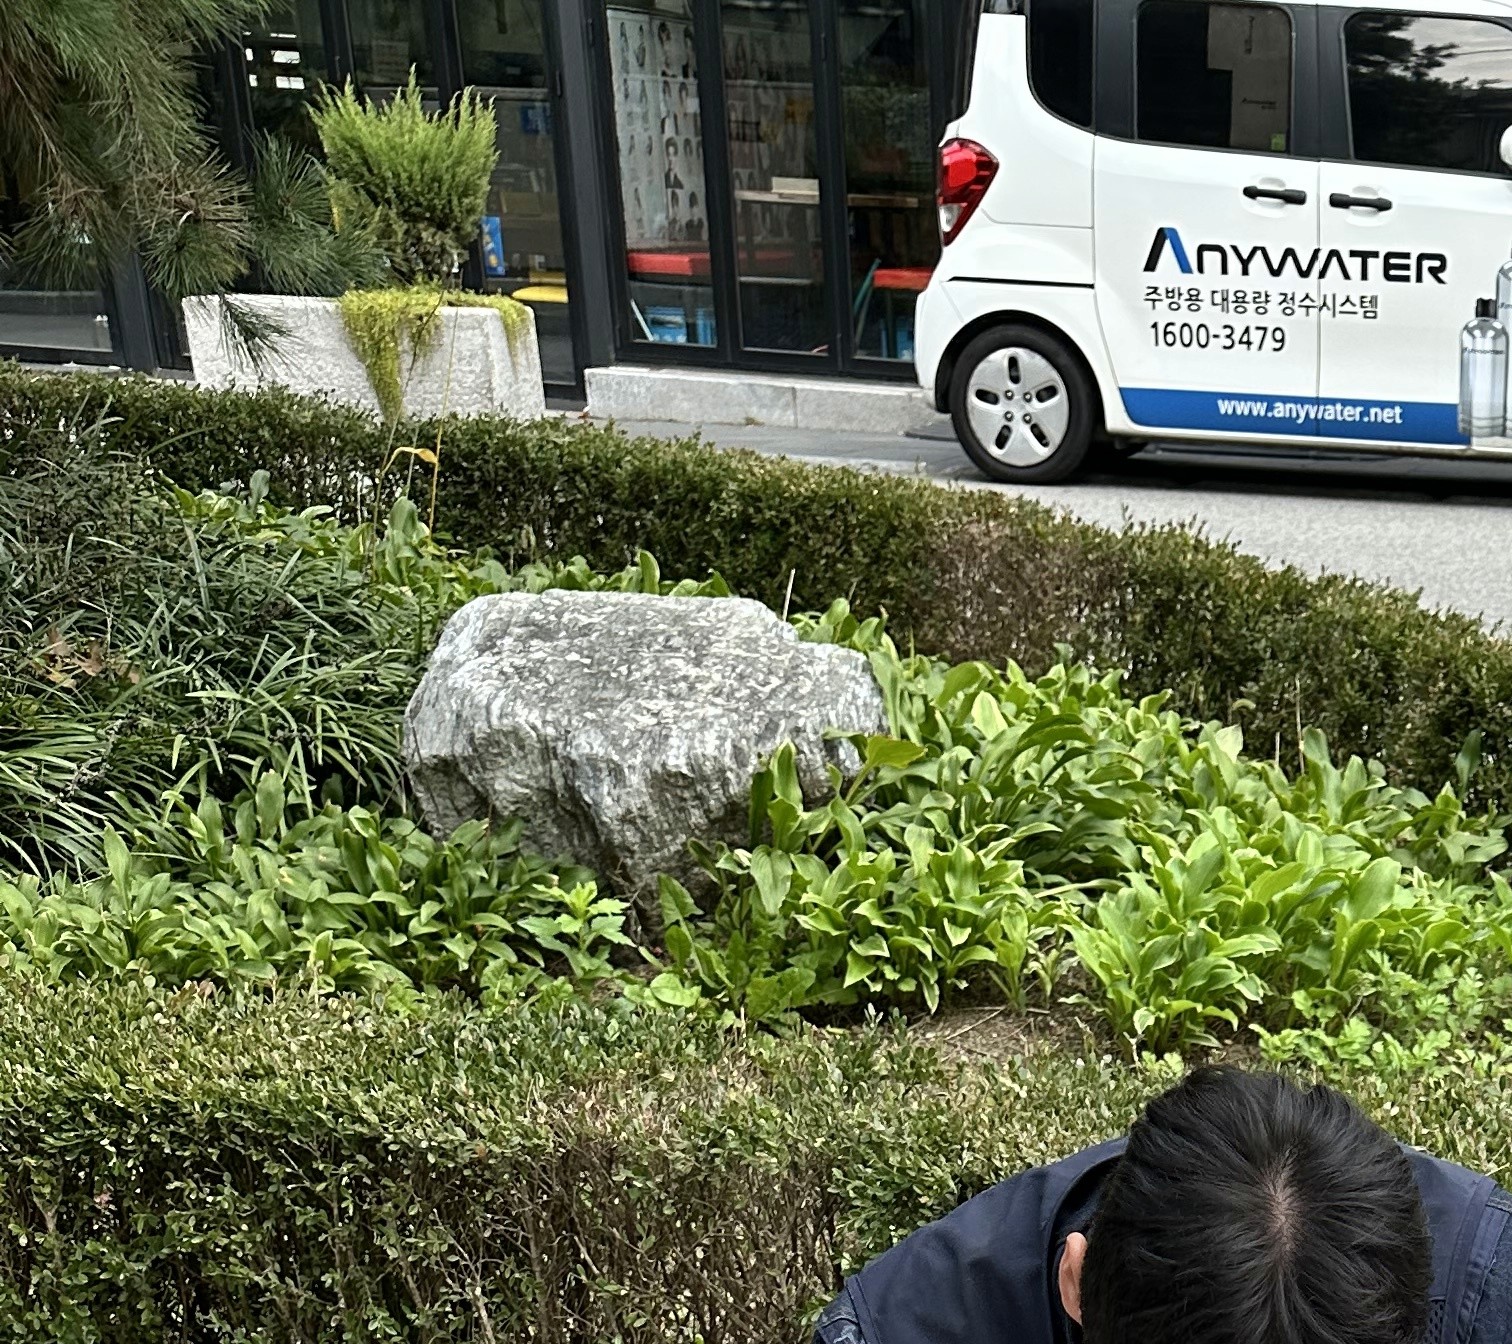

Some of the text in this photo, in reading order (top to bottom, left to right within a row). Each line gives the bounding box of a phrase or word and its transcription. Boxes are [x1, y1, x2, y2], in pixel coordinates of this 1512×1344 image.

[1143, 286, 1379, 320] 주방용 대용량 정수시스템
[1149, 321, 1286, 352] 1600-3479
[1217, 397, 1403, 425] www.anywater.net
